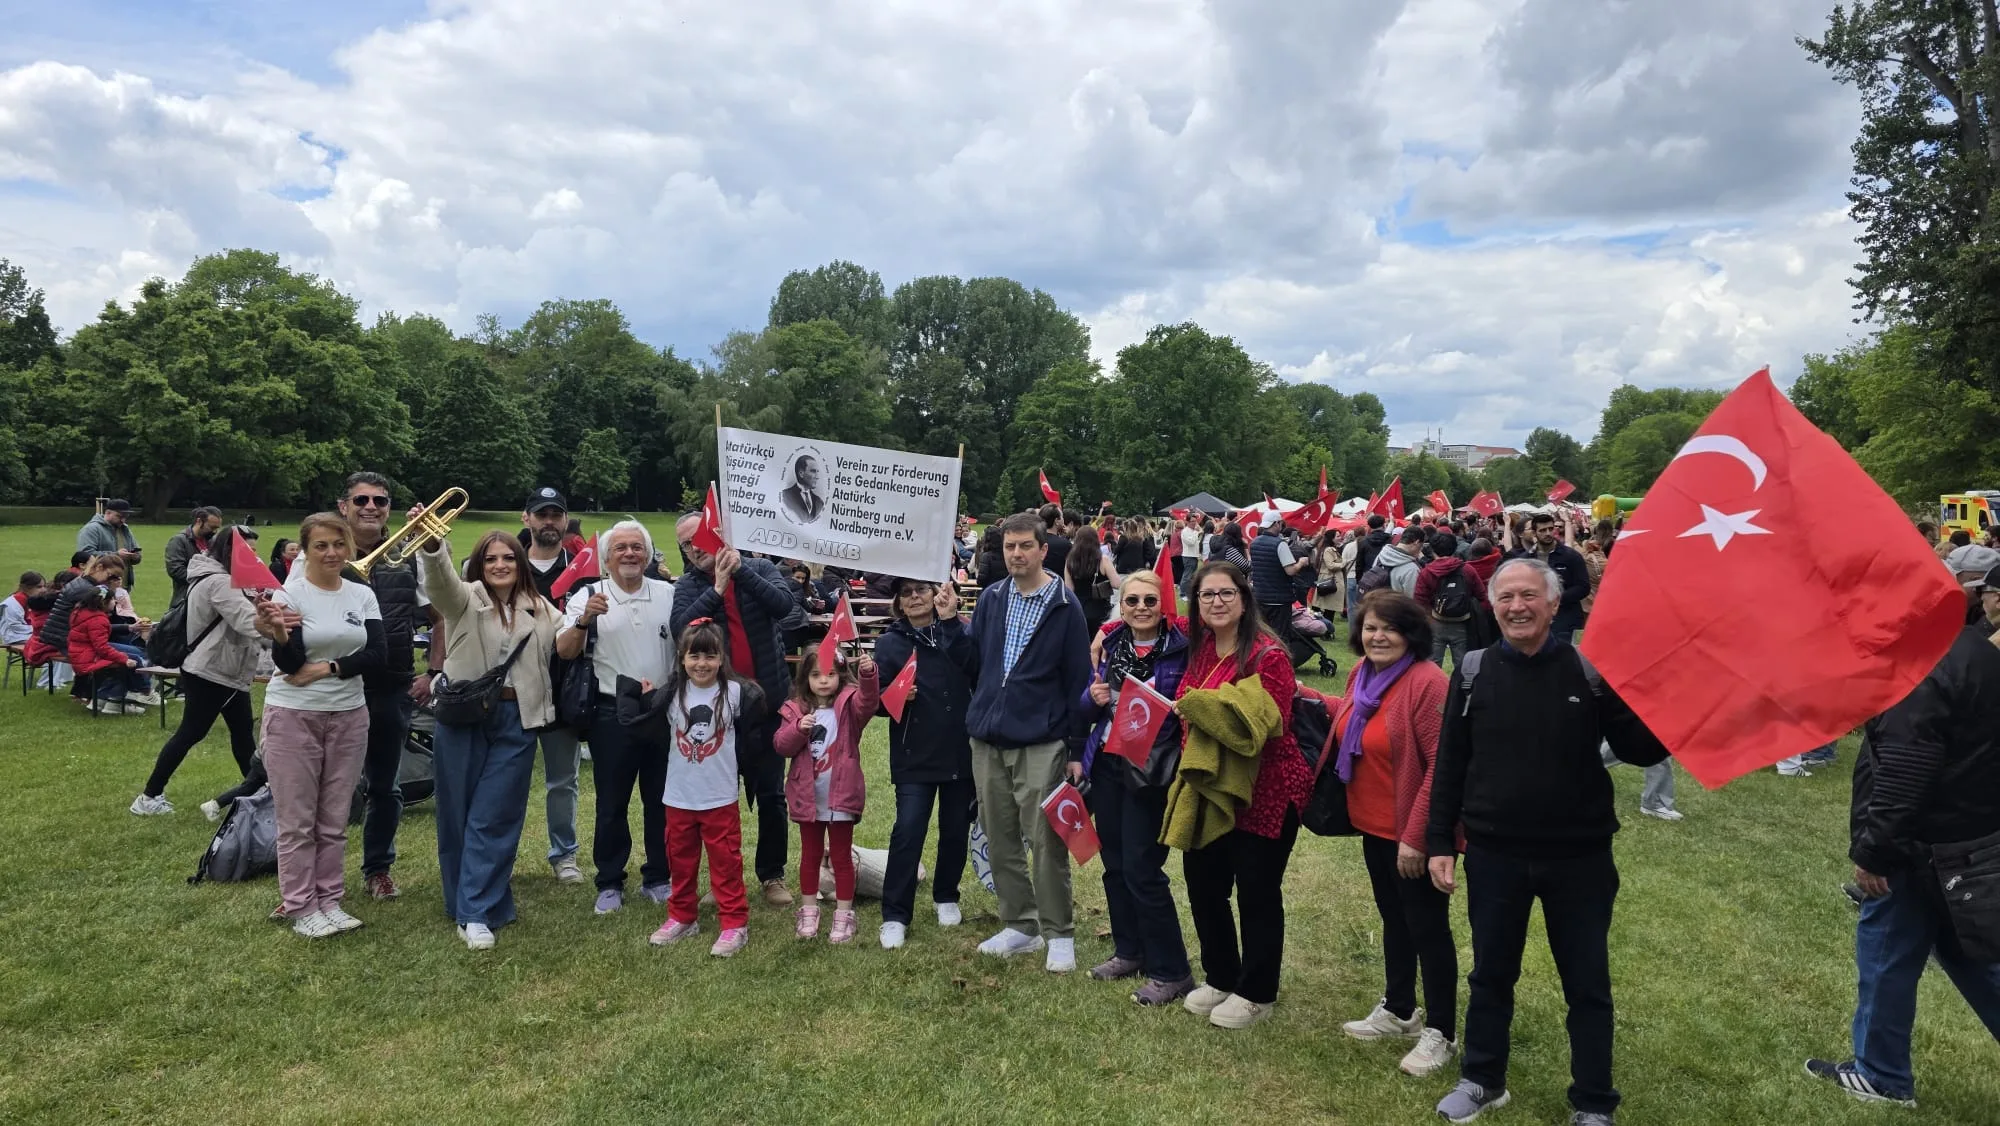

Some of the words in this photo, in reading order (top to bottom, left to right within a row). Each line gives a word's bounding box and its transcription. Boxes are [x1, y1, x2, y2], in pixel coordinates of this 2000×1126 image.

[836, 456, 868, 472] Verein
[872, 464, 889, 475] zur
[892, 464, 949, 486] Förderung
[832, 488, 876, 504] Atatürks
[834, 472, 851, 485] des
[855, 475, 940, 497] Gedankengutes
[831, 503, 880, 524] Nürnberg
[884, 512, 905, 524] und
[830, 518, 891, 538] Nordbayern
[895, 529, 914, 542] e.V.
[747, 528, 797, 548] ADD
[815, 539, 861, 560] NKB
